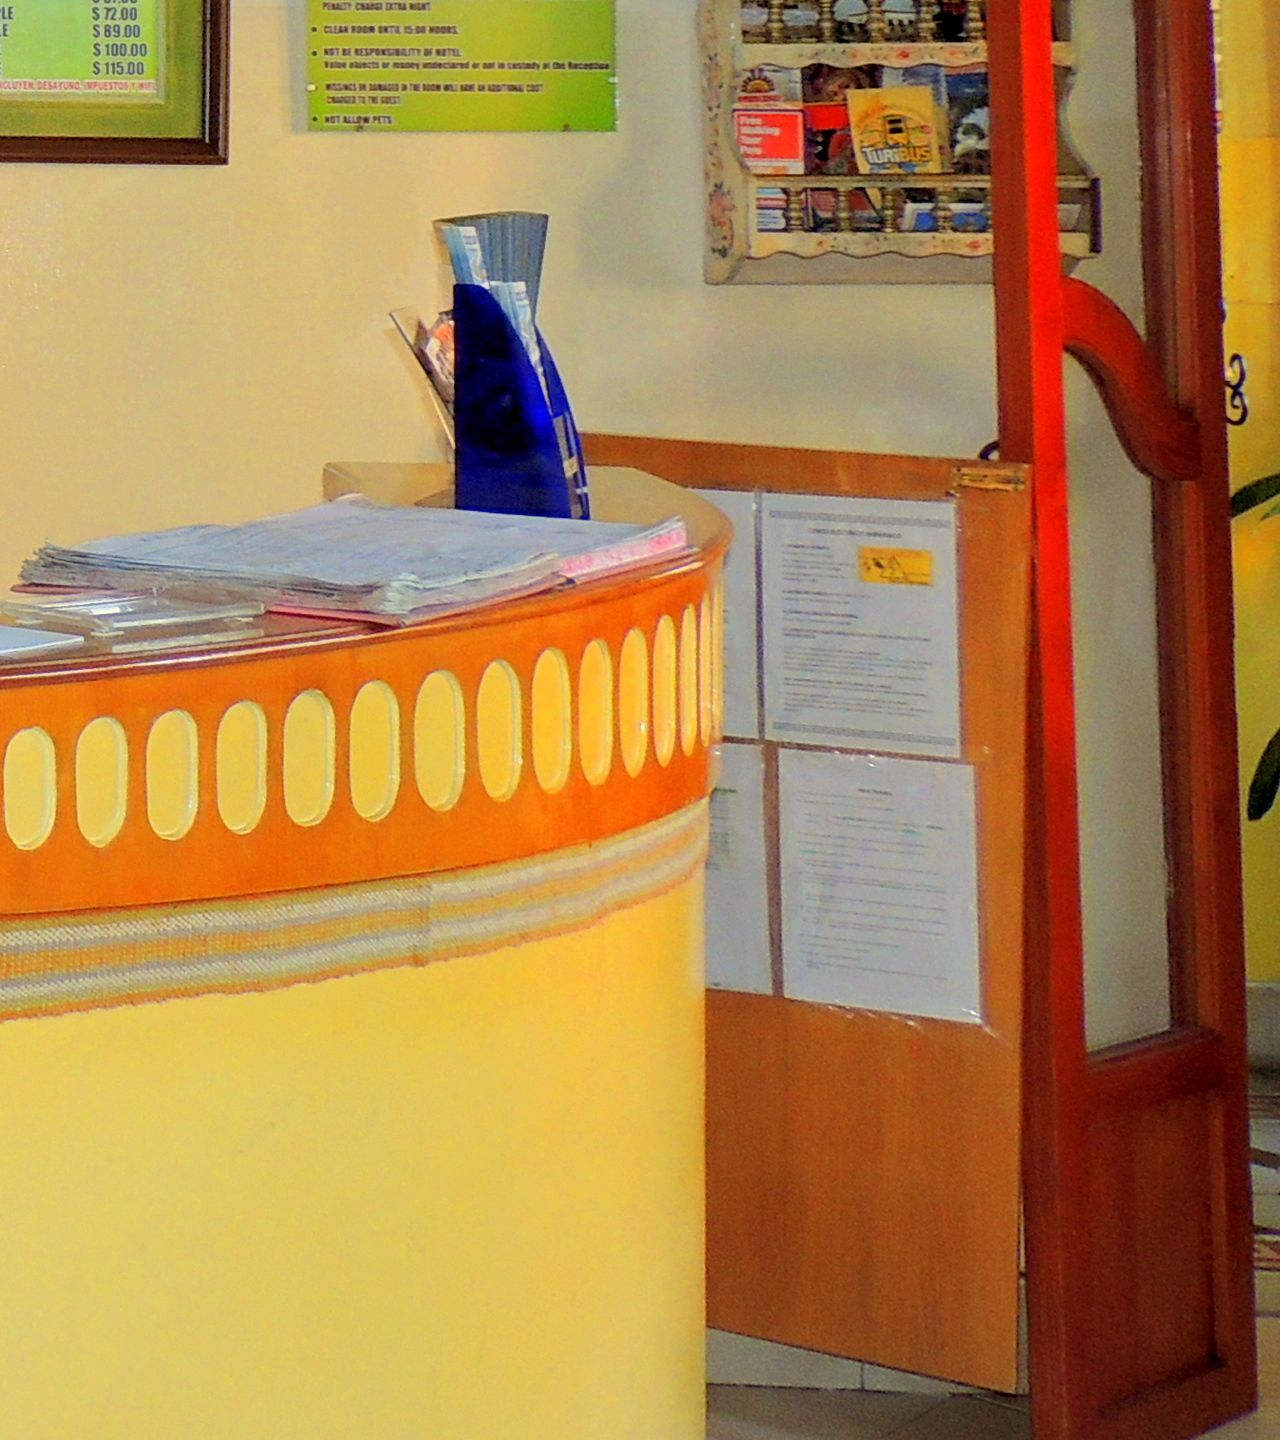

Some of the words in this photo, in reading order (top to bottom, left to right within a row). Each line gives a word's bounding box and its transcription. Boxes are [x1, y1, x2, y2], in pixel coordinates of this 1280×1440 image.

[104, 7, 137, 20] 72.00
[104, 25, 140, 38] 89.00
[105, 43, 147, 57] 100.00
[105, 62, 144, 75] 115.00
